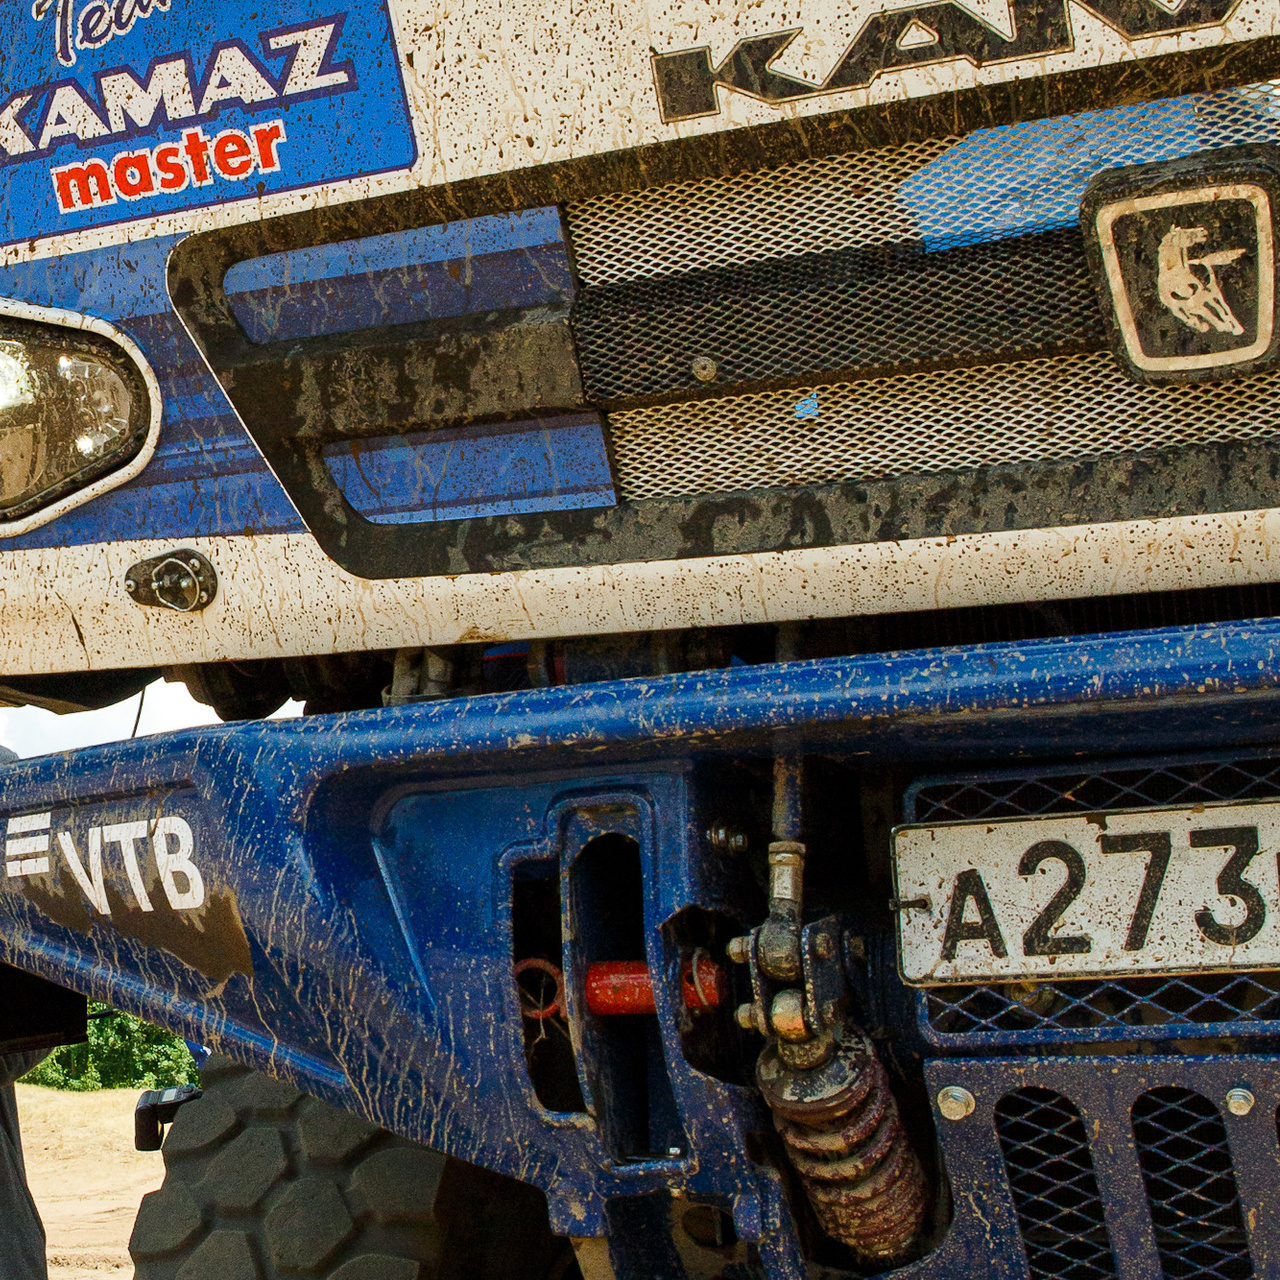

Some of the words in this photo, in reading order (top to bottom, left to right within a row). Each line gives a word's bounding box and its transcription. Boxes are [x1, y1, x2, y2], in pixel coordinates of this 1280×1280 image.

[54, 121, 284, 212] master
[56, 816, 206, 916] VTB
[940, 825, 1280, 962] A273
